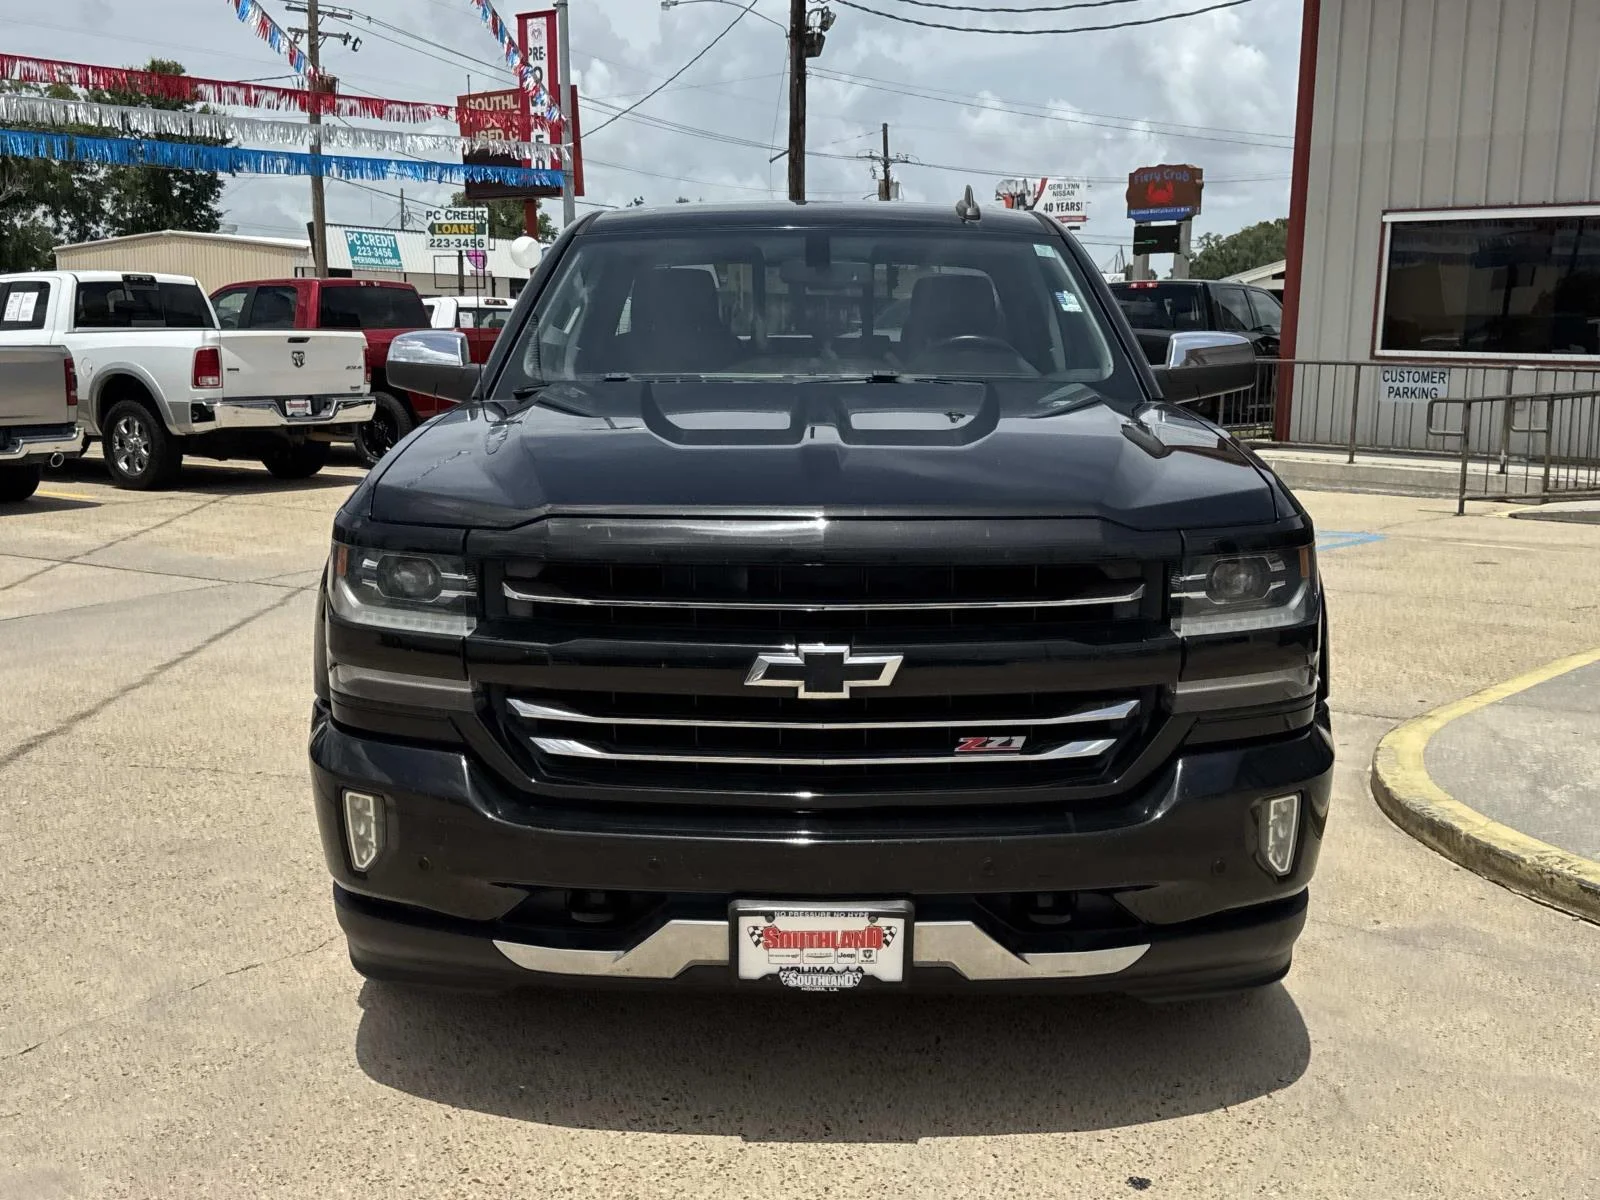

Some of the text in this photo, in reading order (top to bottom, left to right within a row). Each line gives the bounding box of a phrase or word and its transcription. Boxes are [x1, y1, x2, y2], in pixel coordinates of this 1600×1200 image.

[466, 94, 521, 111] SOUTHL
[1043, 201, 1083, 213] 40 YEARS!
[426, 210, 486, 221] PC CREDIT
[435, 223, 477, 234] LOANS
[347, 232, 395, 247] PC CREDIT
[429, 238, 485, 248] 223-3456
[356, 246, 393, 257] 223-3456
[1382, 370, 1446, 384] CUSTOMER
[1387, 386, 1439, 400] PARKING
[954, 736, 1026, 752] Z71
[762, 926, 883, 950] SOUTHLAND
[788, 973, 854, 987] SOUTHLAND
